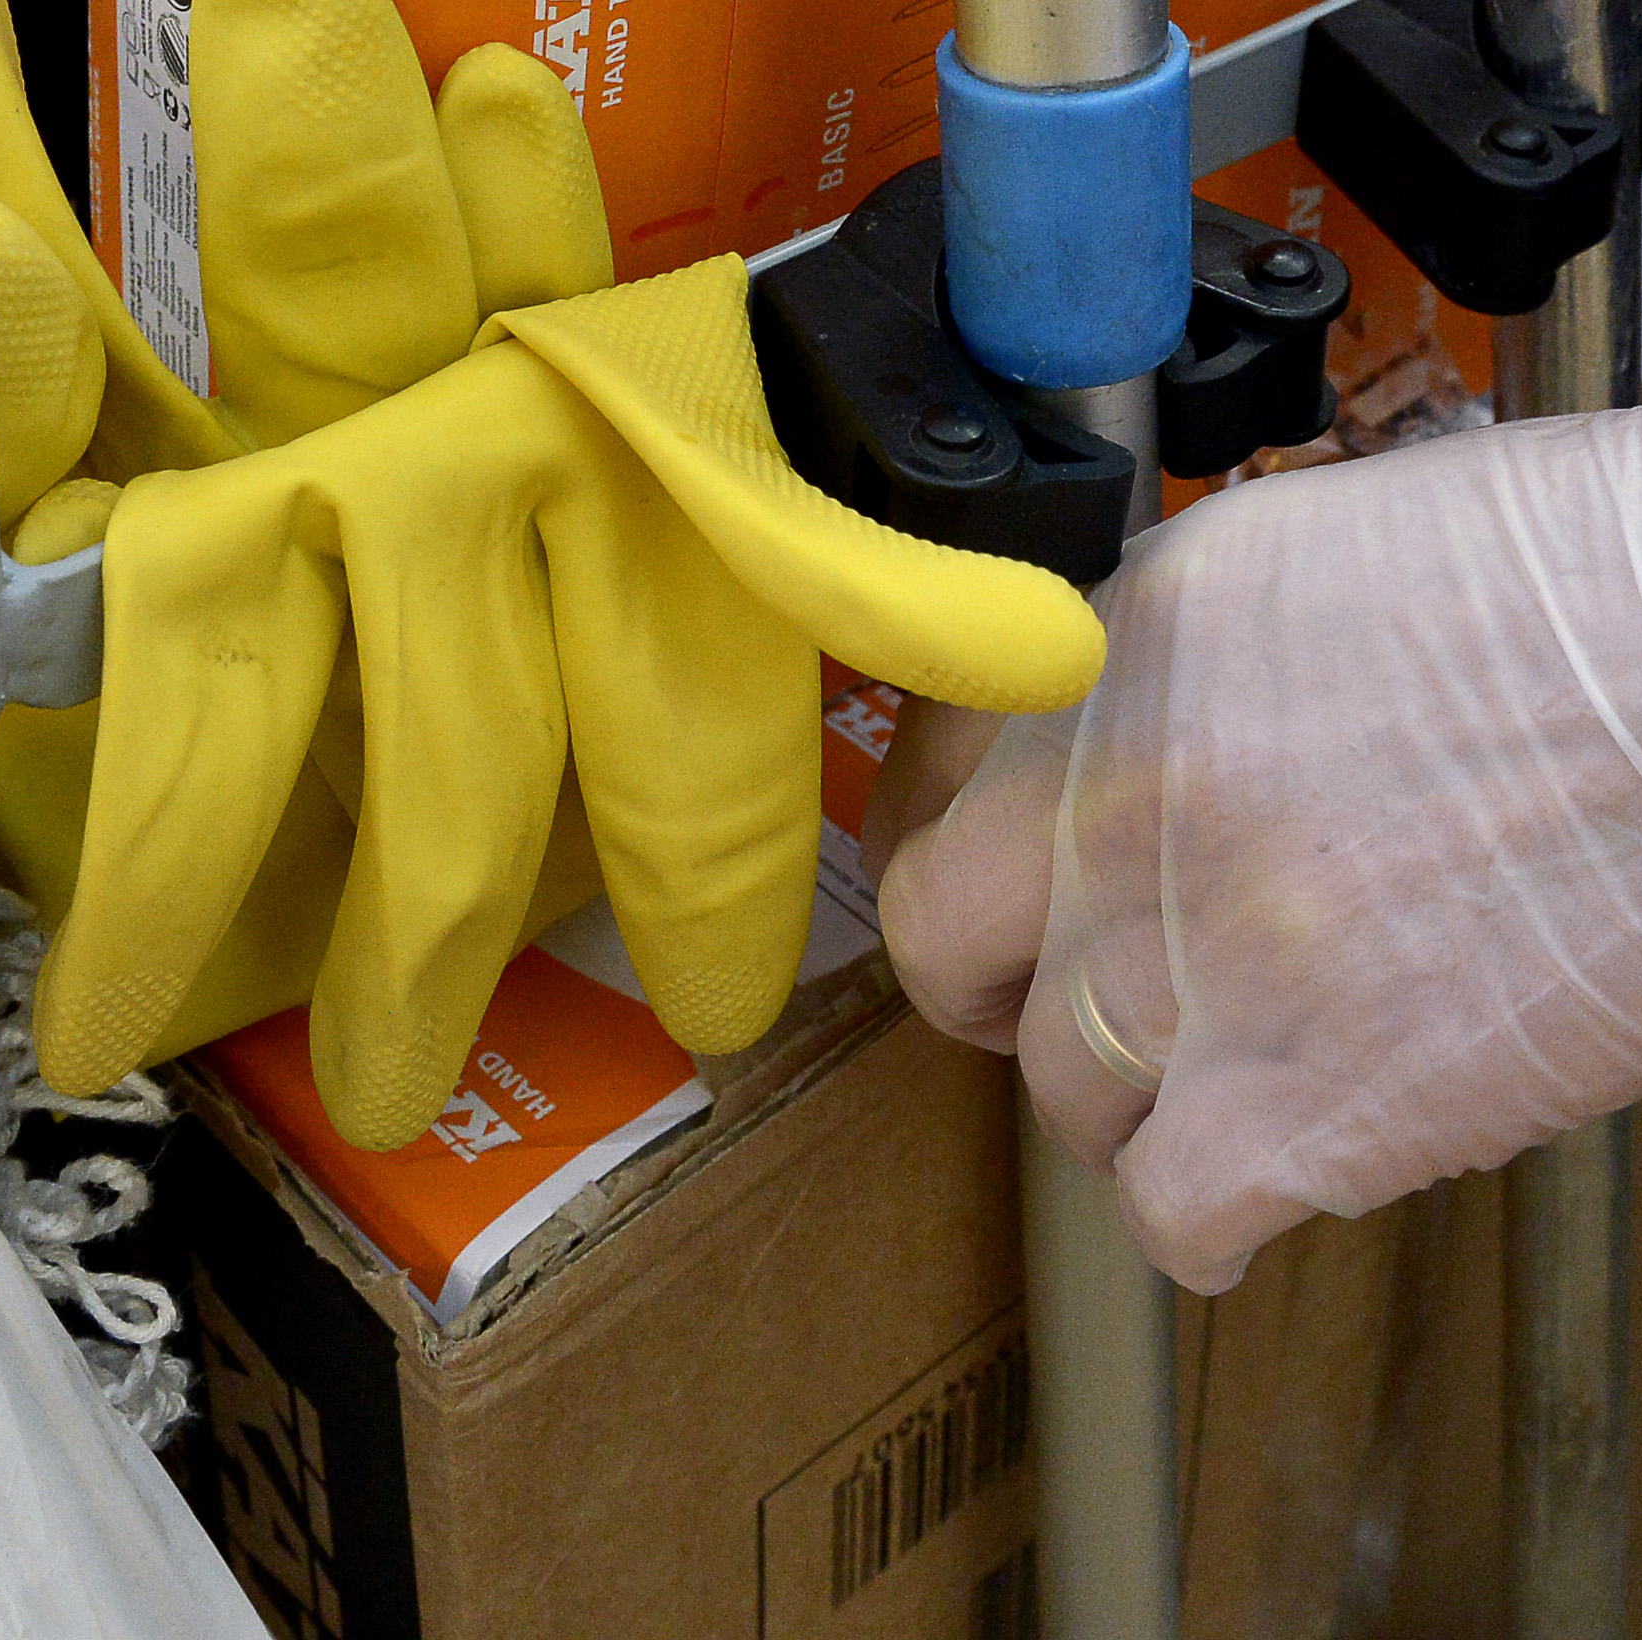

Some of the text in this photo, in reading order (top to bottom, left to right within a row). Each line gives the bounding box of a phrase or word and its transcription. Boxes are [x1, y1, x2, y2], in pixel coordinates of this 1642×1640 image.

[600, 17, 630, 109] HAND
[815, 87, 855, 192] BASIC
[477, 1051, 557, 1121] HAND
